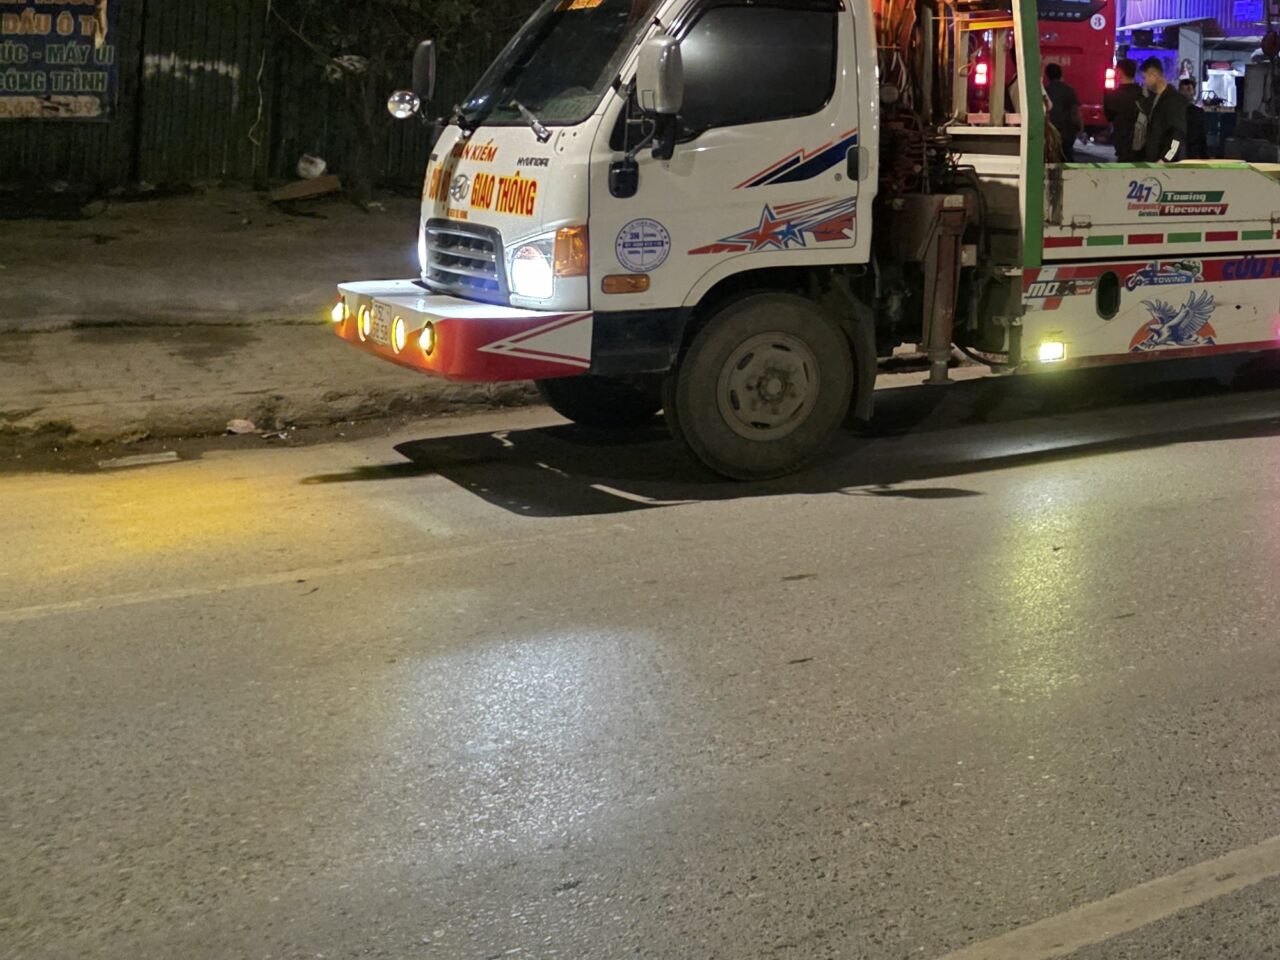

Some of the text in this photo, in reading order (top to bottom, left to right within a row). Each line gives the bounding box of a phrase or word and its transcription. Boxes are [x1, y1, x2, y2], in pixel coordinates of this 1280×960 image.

[471, 172, 496, 209] GIAO
[495, 170, 537, 217] THÔNG
[1153, 275, 1187, 284] TOWING
